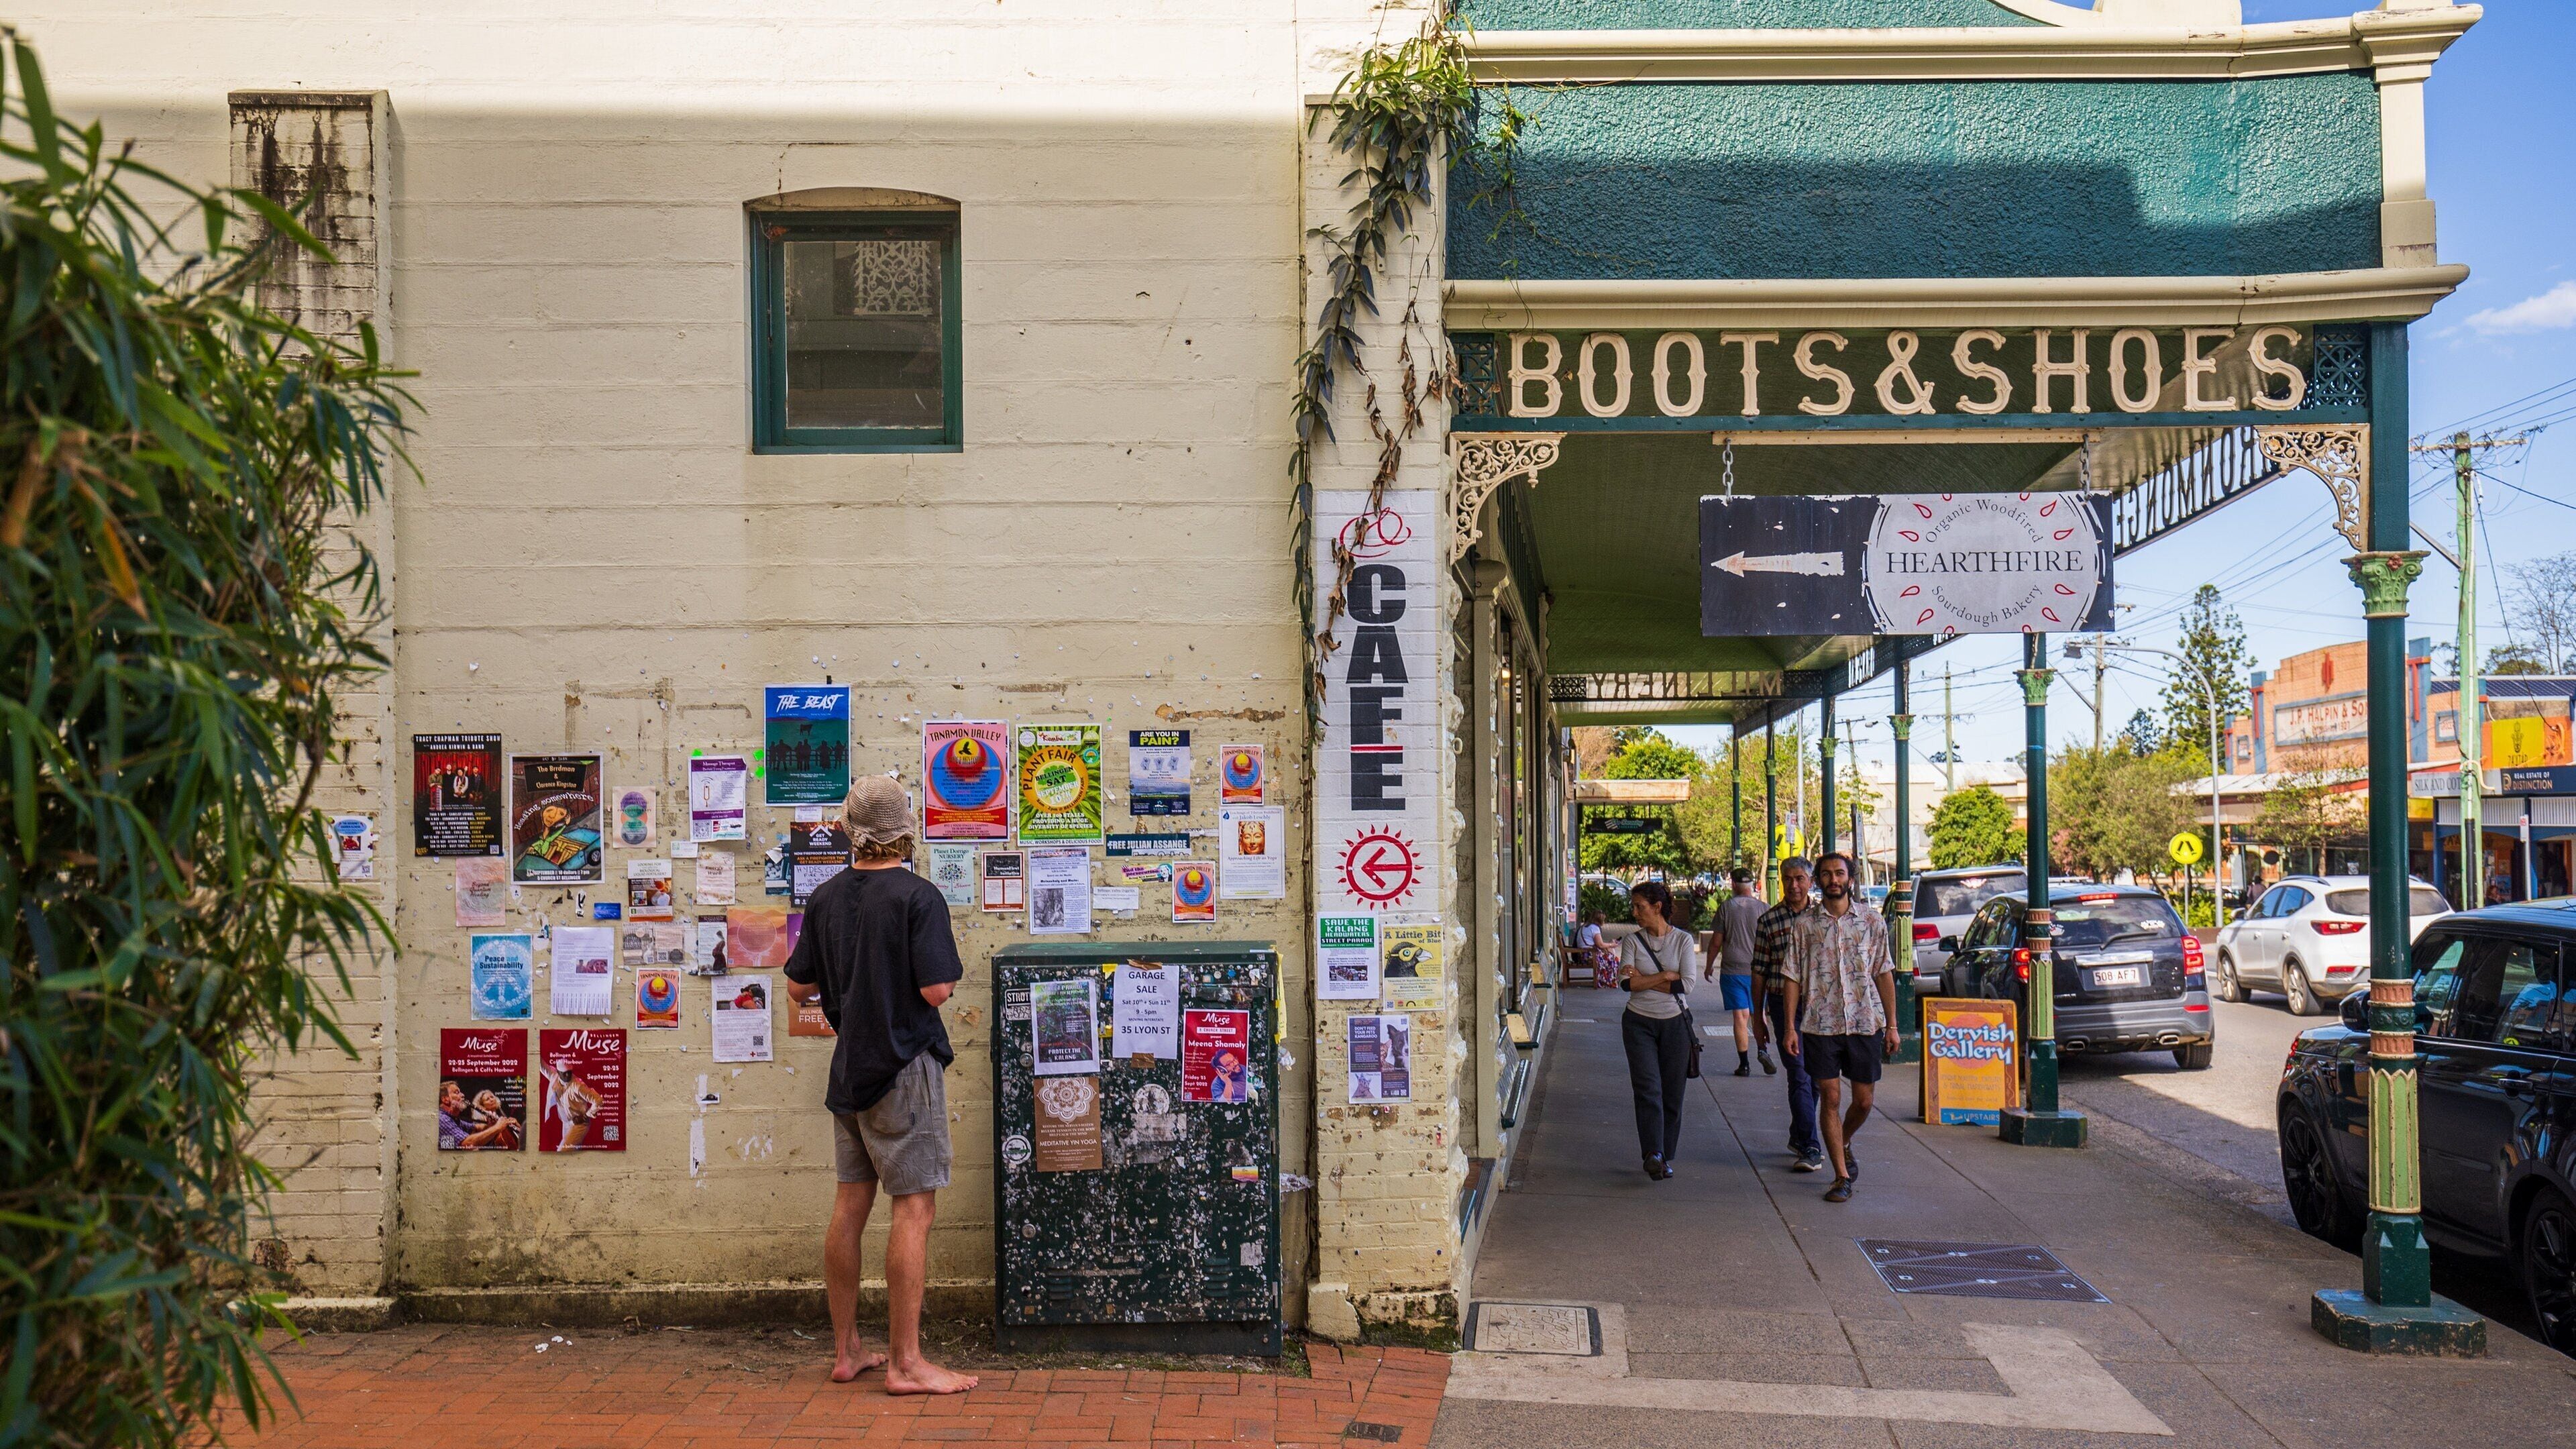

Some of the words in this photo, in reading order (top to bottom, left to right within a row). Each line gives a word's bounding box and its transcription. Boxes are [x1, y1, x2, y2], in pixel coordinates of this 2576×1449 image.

[1926, 504, 1972, 543] Organic
[1976, 499, 2043, 543] Woodfired
[1886, 550, 2084, 575] HEARTHFIRE
[1932, 586, 1998, 627] Sourdough
[2002, 584, 2043, 620] Bakery
[1346, 564, 1409, 811] CAFE
[776, 694, 801, 713] THE
[800, 694, 845, 712] BEAST
[2308, 706, 2339, 722] HALPIN
[2342, 703, 2348, 718] &
[929, 728, 969, 742] TANAMON
[1140, 737, 1179, 745] PAIN?
[1023, 753, 1046, 791] PLANT
[1047, 749, 1077, 763] FAIR
[1035, 766, 1074, 781] BELLINGEN
[556, 781, 577, 789] Kingston
[1046, 775, 1066, 787] SAT
[2415, 778, 2428, 792] SILK
[2430, 777, 2445, 791] AND
[2512, 780, 2553, 791] DISTINCTION
[1037, 781, 1079, 798] SEPTEMBER
[515, 804, 541, 830] Heading
[541, 792, 594, 806] somewhere
[1109, 841, 1126, 849] FREE
[1127, 841, 1152, 849] JULIAN
[1152, 840, 1187, 849] ASSANGE
[1385, 931, 1392, 939] A
[1395, 930, 1423, 939] Little
[1426, 930, 1441, 938] Bit
[479, 961, 523, 969] Sustainability
[1129, 971, 1165, 979] GARAGE
[2095, 972, 2113, 982] 508
[1136, 985, 1157, 994] SALE
[798, 1015, 823, 1023] FREE
[1201, 1012, 1230, 1025] Muse
[1122, 1026, 1132, 1034] 35
[1161, 1026, 1171, 1034] ST
[1927, 1022, 2015, 1042] Dervish
[460, 1036, 497, 1053] Muse
[560, 1030, 620, 1055] Muse
[1188, 1039, 1213, 1047] Meena
[1215, 1040, 1246, 1050] Shamaly
[1930, 1040, 2012, 1065] Gallery
[466, 1059, 500, 1067] September
[587, 1073, 619, 1081] September
[1964, 1113, 2000, 1122] UPSTAIRS
